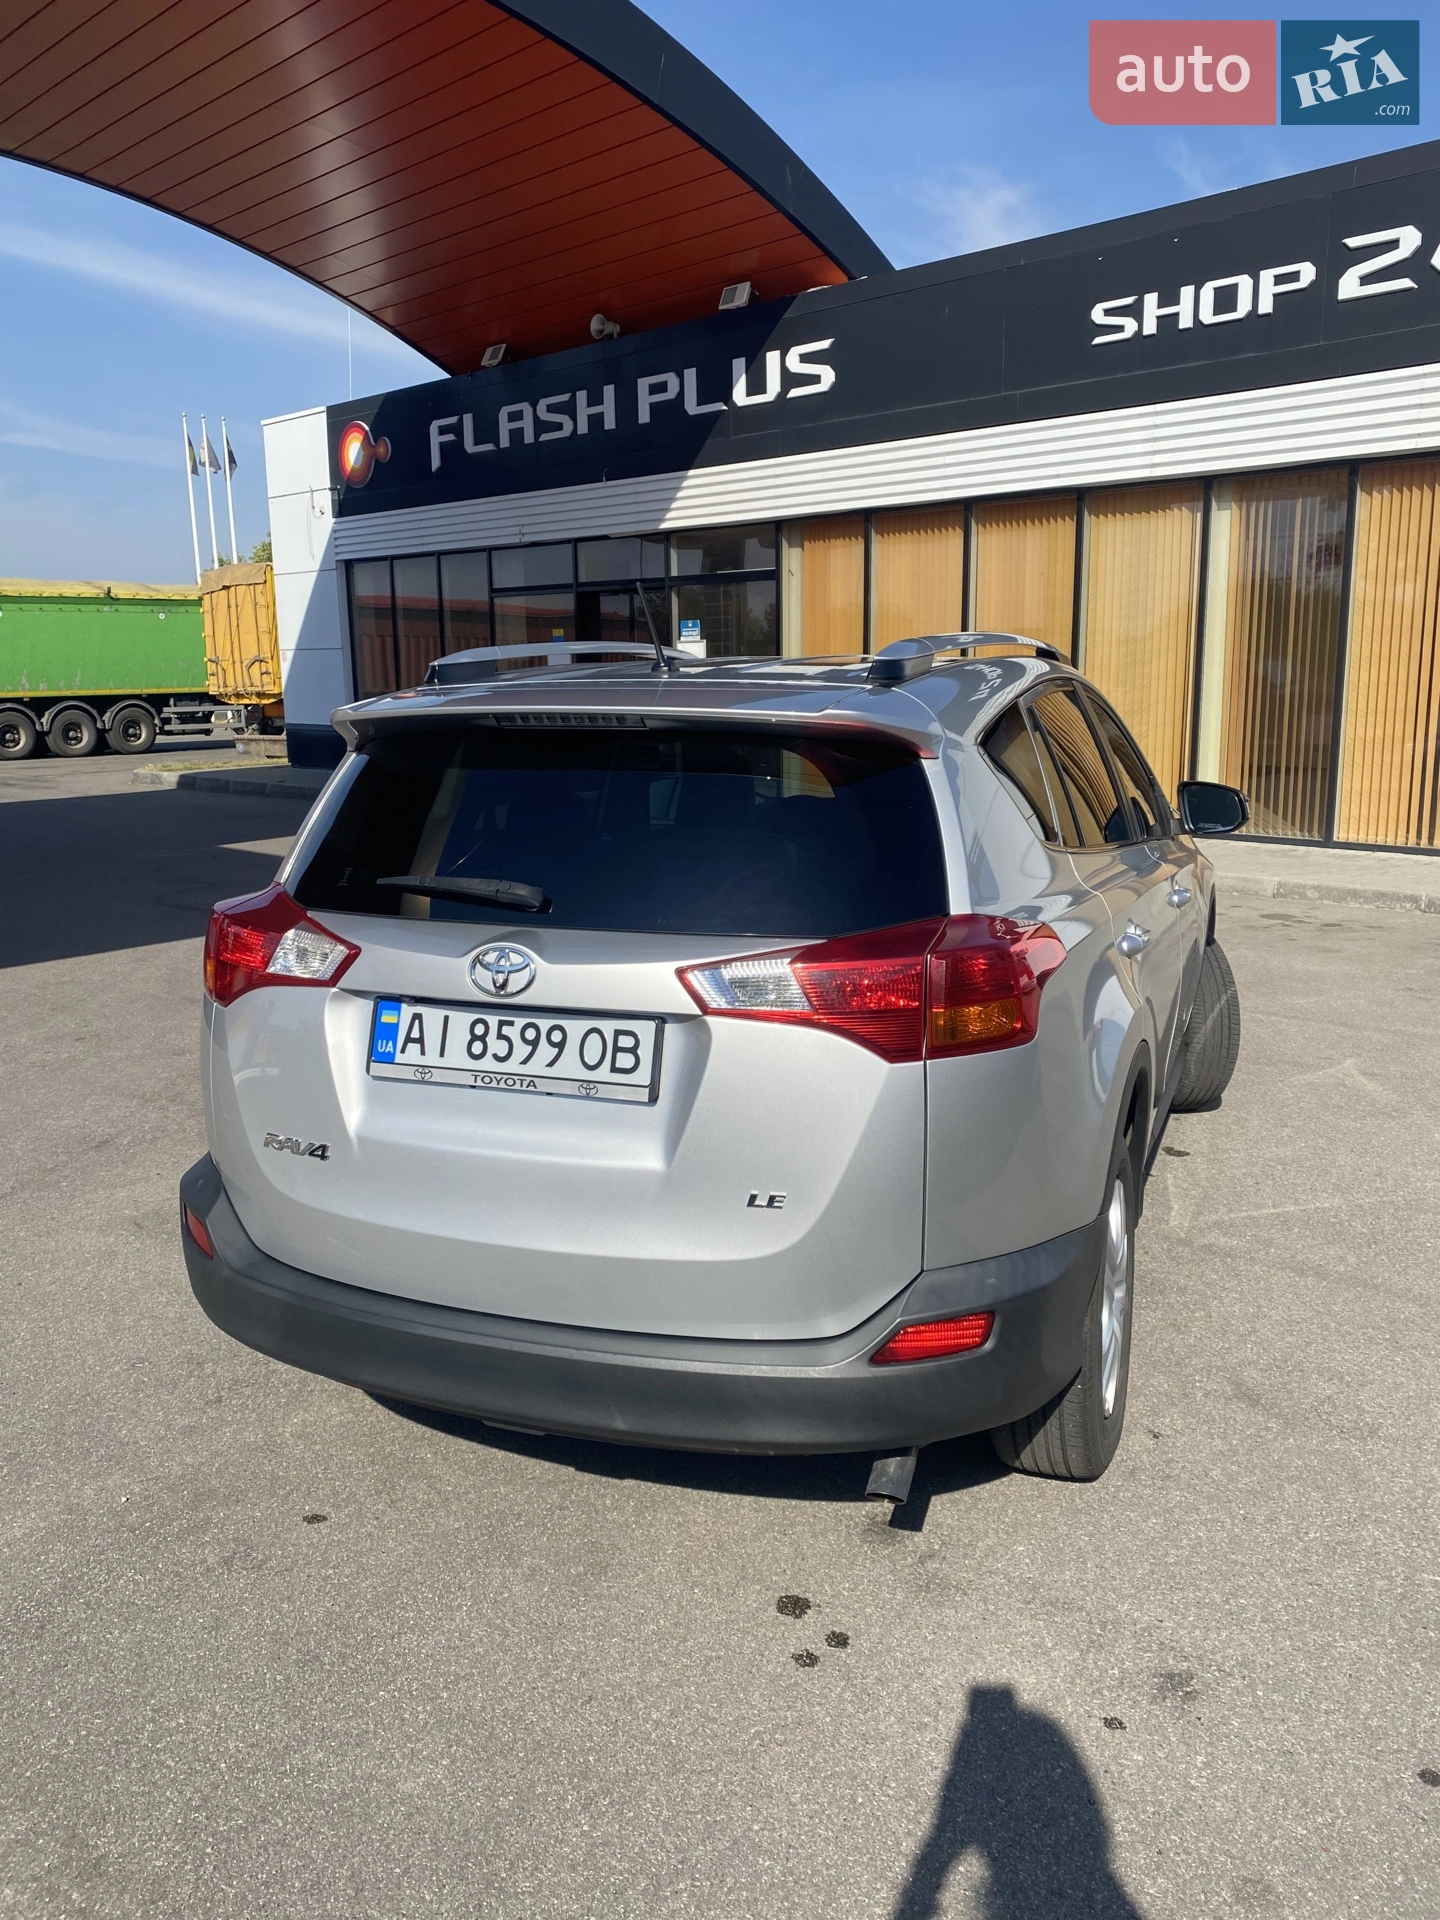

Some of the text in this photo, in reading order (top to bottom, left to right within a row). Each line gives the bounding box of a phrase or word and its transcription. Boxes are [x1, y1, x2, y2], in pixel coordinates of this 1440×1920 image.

[1090, 224, 1440, 346] SHOP 2
[429, 338, 836, 472] FLASH PLUS
[377, 1039, 394, 1053] UA
[400, 1012, 641, 1075] AI 8599 OB
[471, 1073, 538, 1090] TOYOTA
[263, 1132, 332, 1161] RAV4
[746, 1190, 787, 1209] LE
